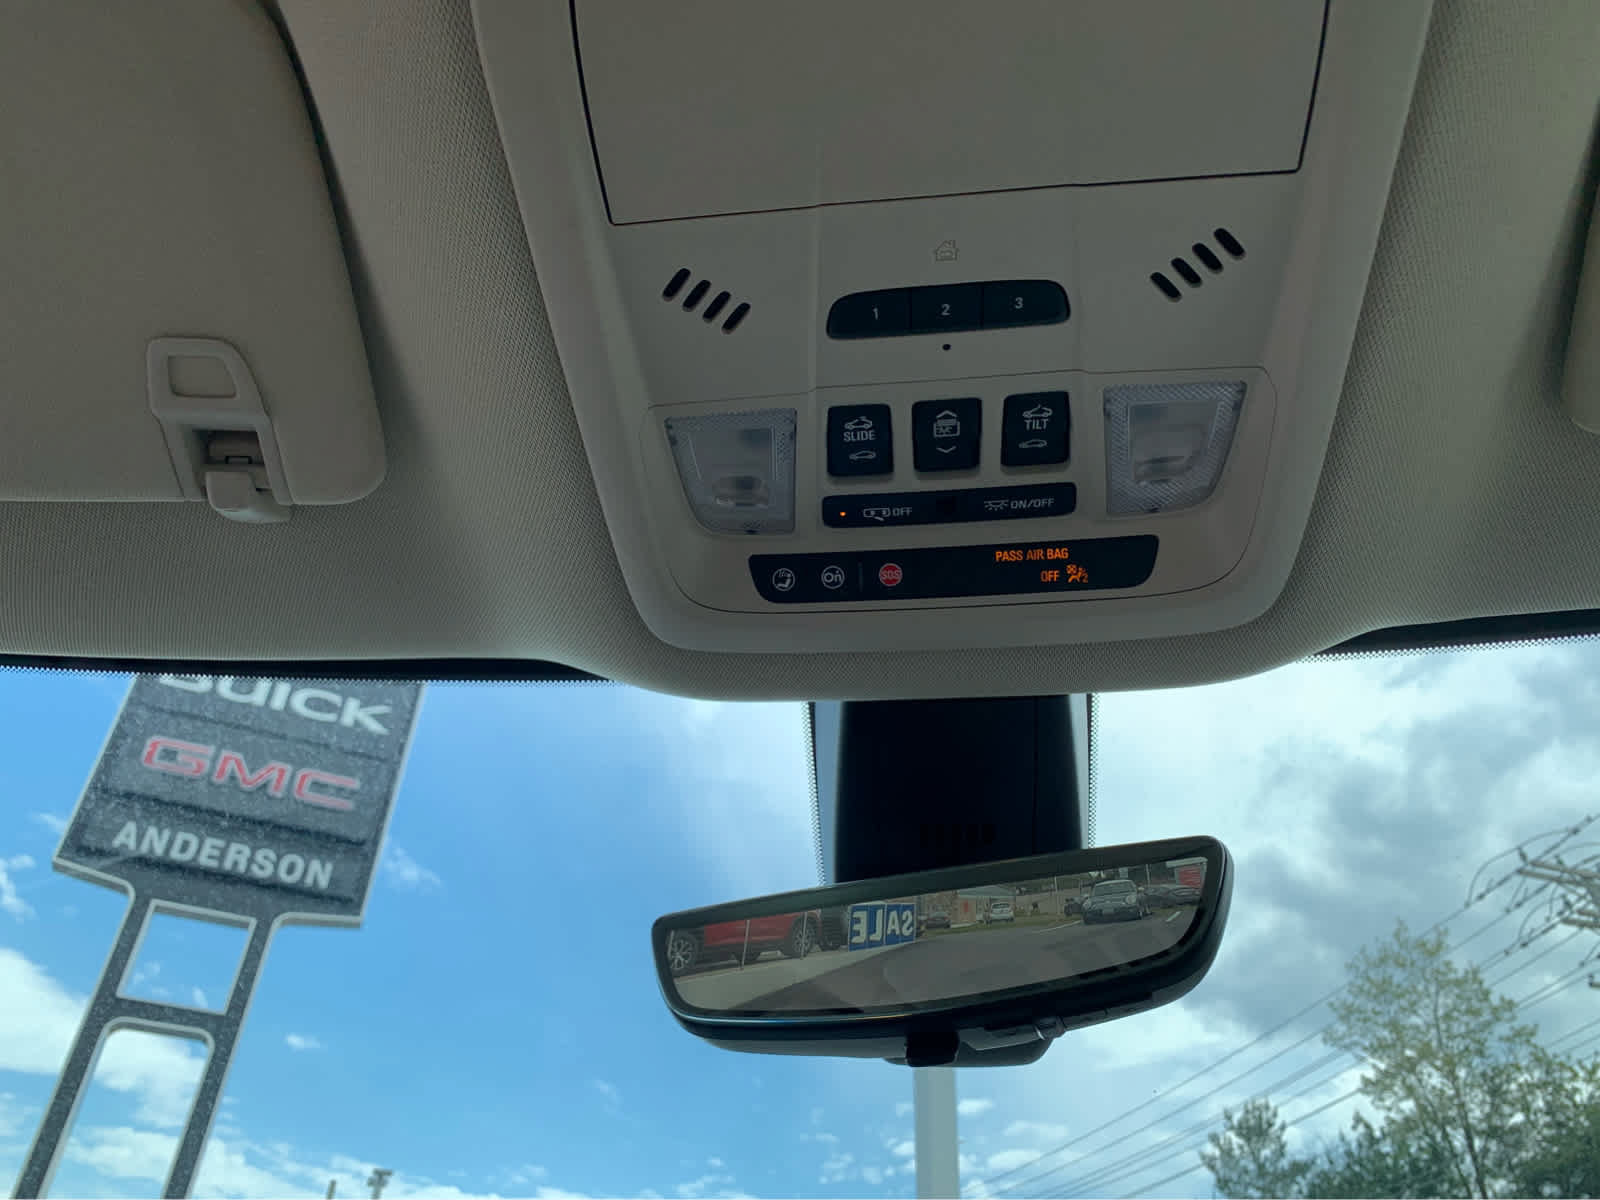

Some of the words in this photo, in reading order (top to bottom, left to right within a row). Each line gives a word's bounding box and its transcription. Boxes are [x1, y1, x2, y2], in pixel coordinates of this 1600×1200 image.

[1015, 297, 1023, 309] 3
[873, 307, 879, 320] 1
[942, 304, 950, 316] 2
[1023, 418, 1049, 430] TILT
[843, 429, 876, 442] SLIDE
[1010, 497, 1055, 510] ON/OFF
[892, 506, 913, 517] OFF
[995, 550, 1024, 562] PASS
[1026, 548, 1045, 561] AIR
[1046, 547, 1069, 560] BAG
[881, 569, 901, 581] SOS
[1040, 569, 1060, 582] OFF
[142, 736, 361, 811] GMC
[112, 821, 333, 889] ANDERSON
